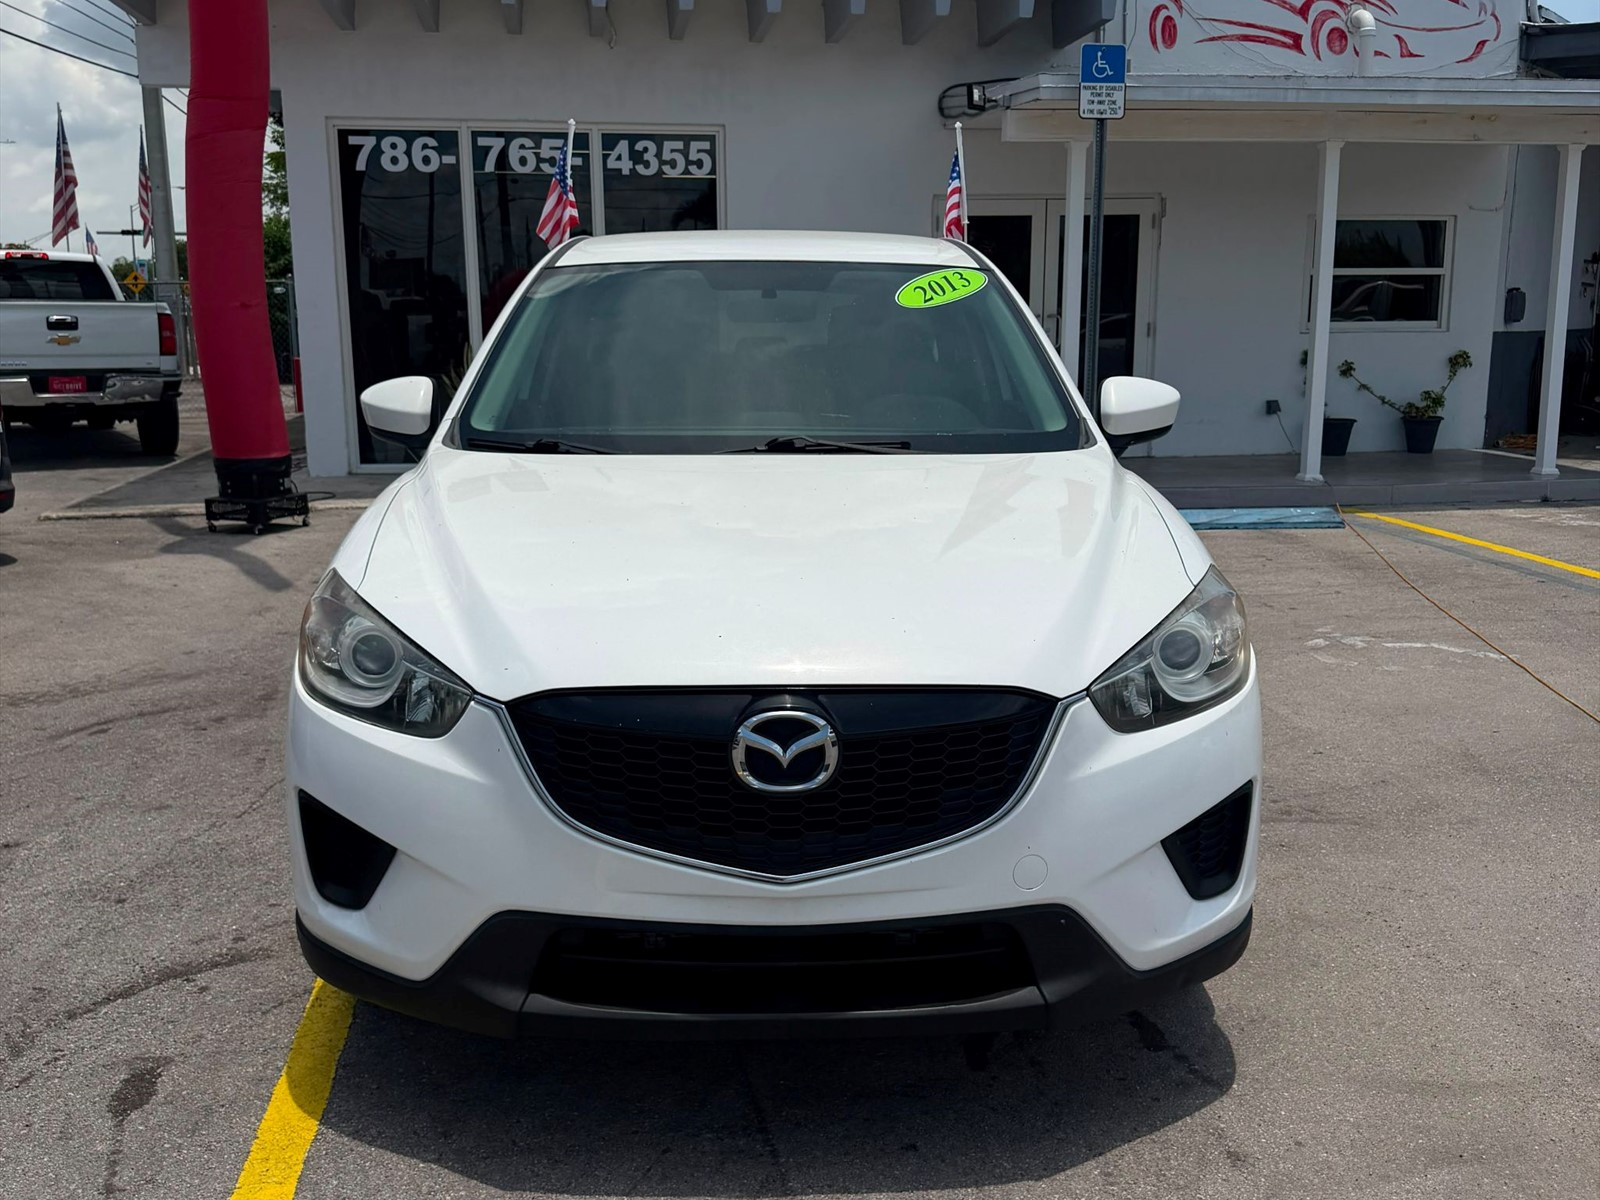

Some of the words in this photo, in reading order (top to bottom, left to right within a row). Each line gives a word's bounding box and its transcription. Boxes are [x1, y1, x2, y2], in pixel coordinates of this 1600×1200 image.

[348, 135, 456, 173] 786-
[607, 139, 713, 176] 4355
[913, 271, 971, 304] 2013
